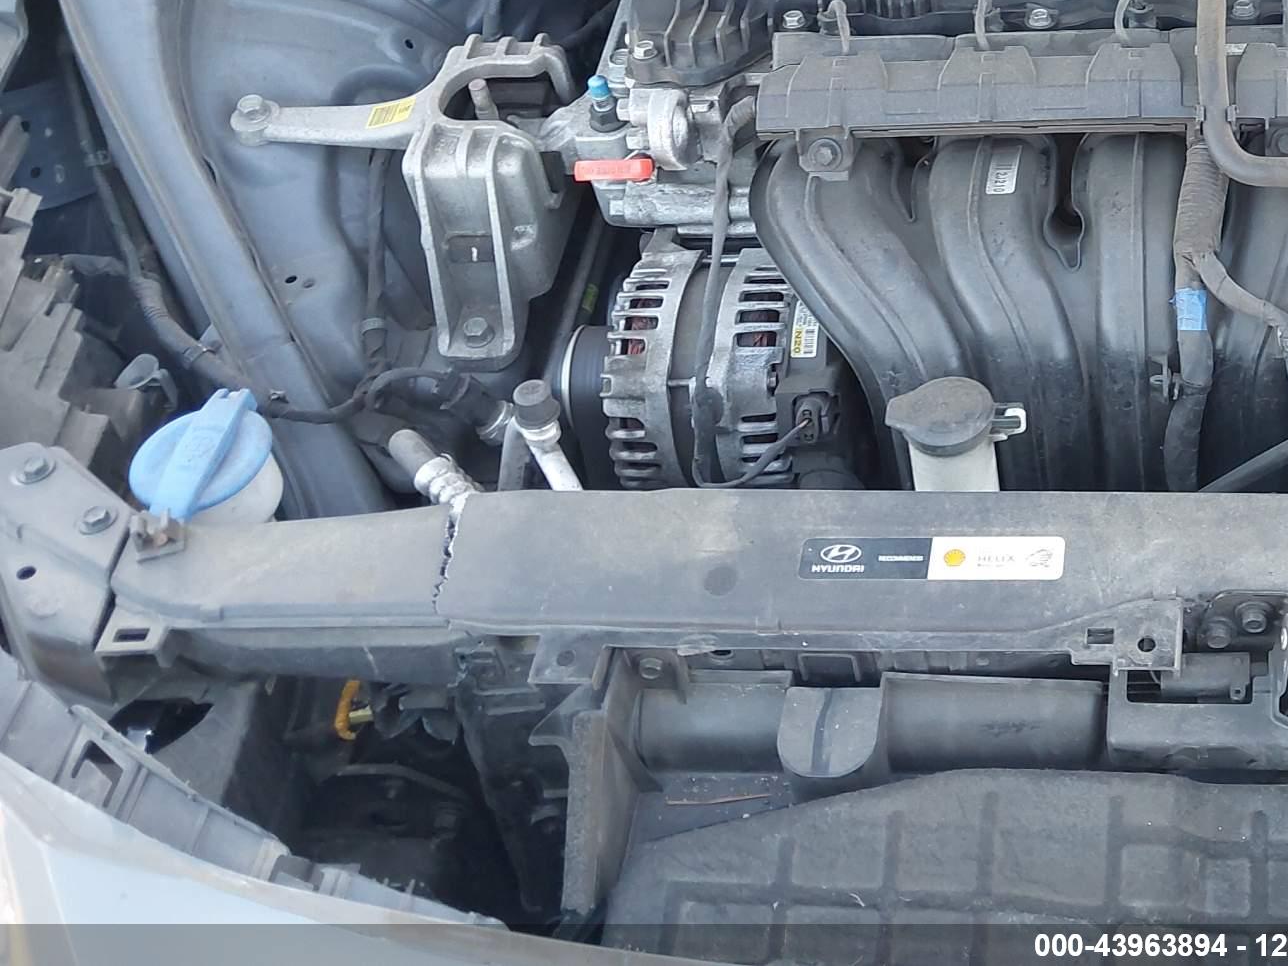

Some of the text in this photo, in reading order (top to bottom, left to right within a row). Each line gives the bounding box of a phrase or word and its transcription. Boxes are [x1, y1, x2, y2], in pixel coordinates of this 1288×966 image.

[793, 330, 803, 354] N20
[977, 555, 1016, 563] HELIX
[811, 564, 865, 573] HYUNDAI
